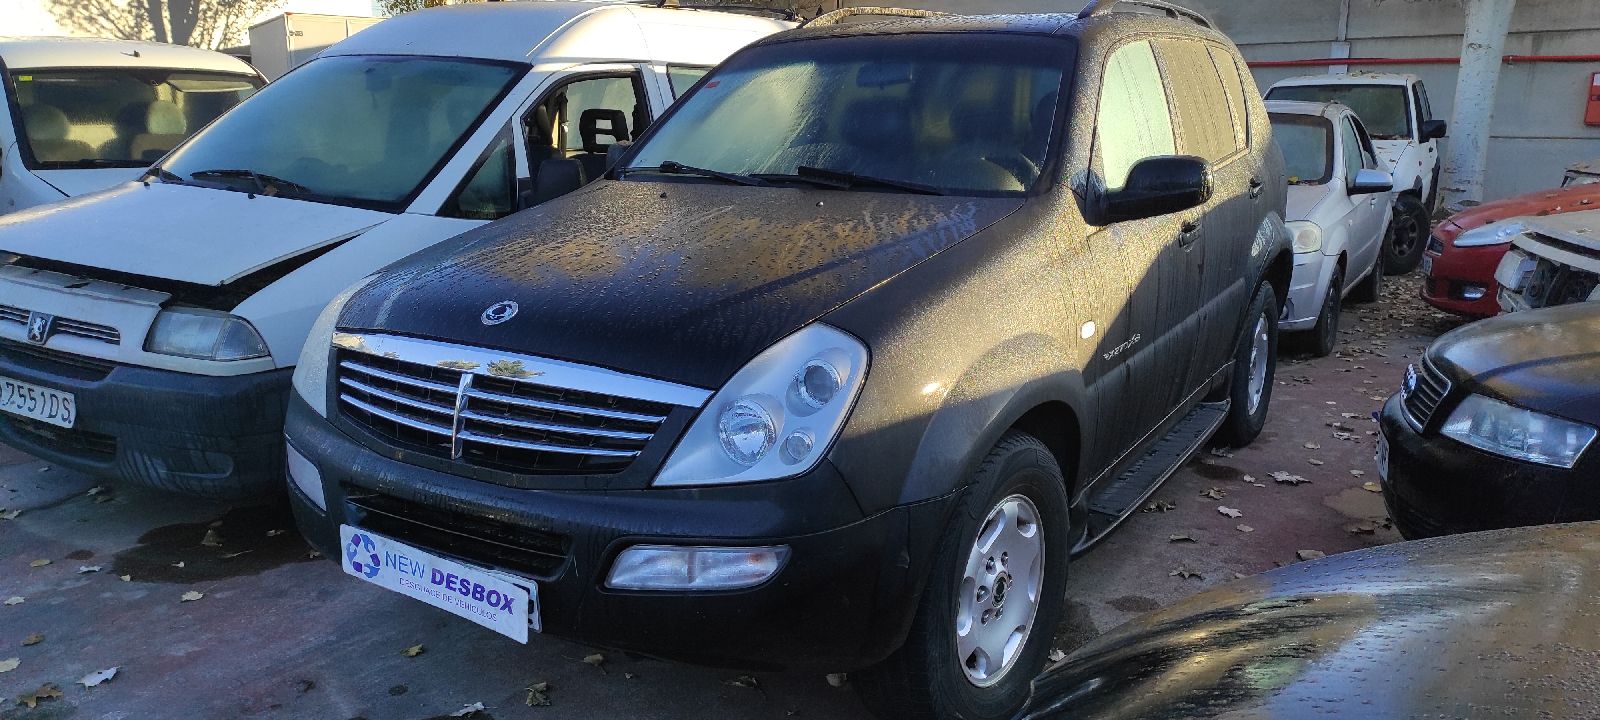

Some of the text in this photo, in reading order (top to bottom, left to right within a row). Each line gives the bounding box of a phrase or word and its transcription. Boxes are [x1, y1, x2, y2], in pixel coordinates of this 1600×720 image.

[385, 550, 425, 579] NEW
[430, 567, 516, 615] DESBOX
[399, 577, 440, 599] DESGUACE
[442, 593, 453, 604] DE
